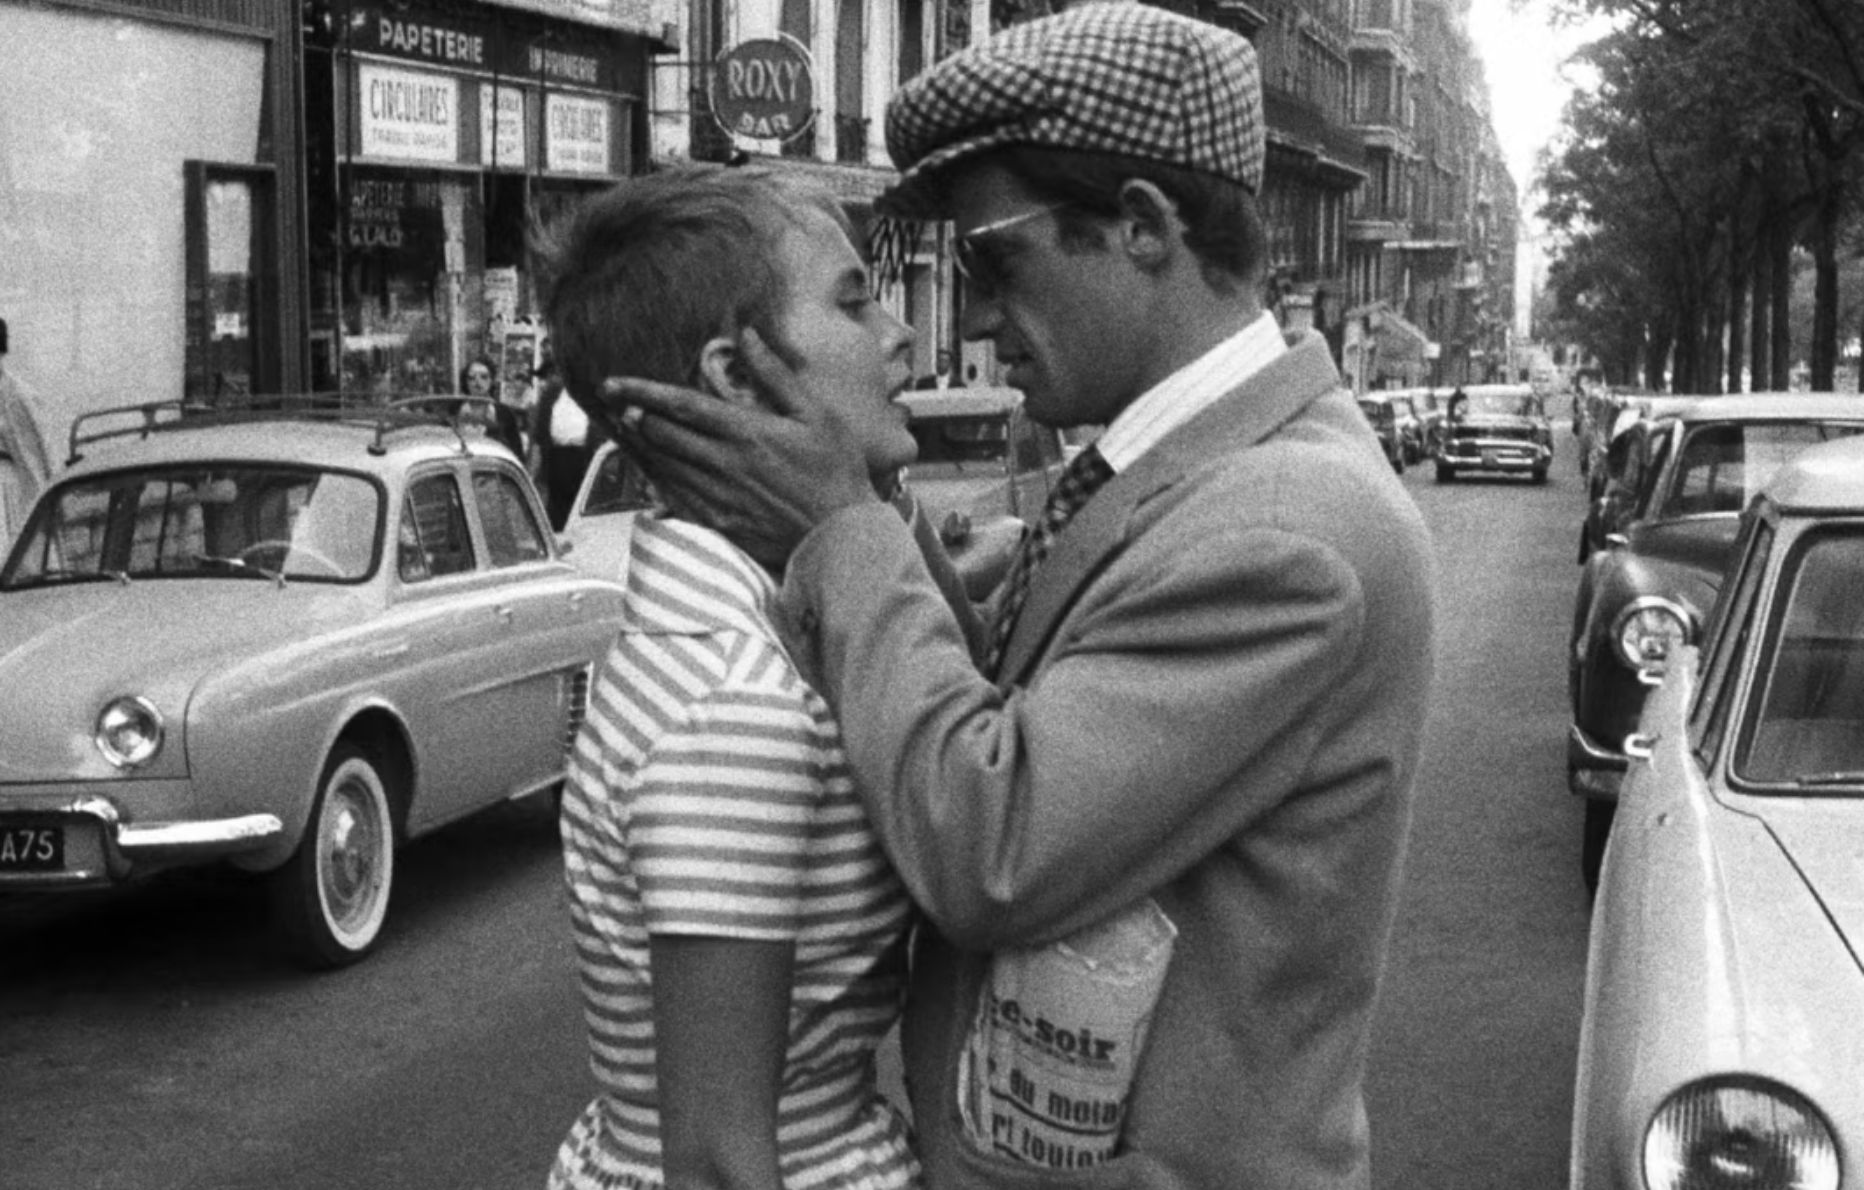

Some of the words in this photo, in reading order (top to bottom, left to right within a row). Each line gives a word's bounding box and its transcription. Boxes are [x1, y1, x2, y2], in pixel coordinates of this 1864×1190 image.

[380, 19, 483, 63] PAPETERIE
[370, 79, 448, 125] CIRCULAIRES
[728, 59, 800, 102] ROXY
[736, 111, 791, 136] BAR
[1, 830, 54, 862] A75
